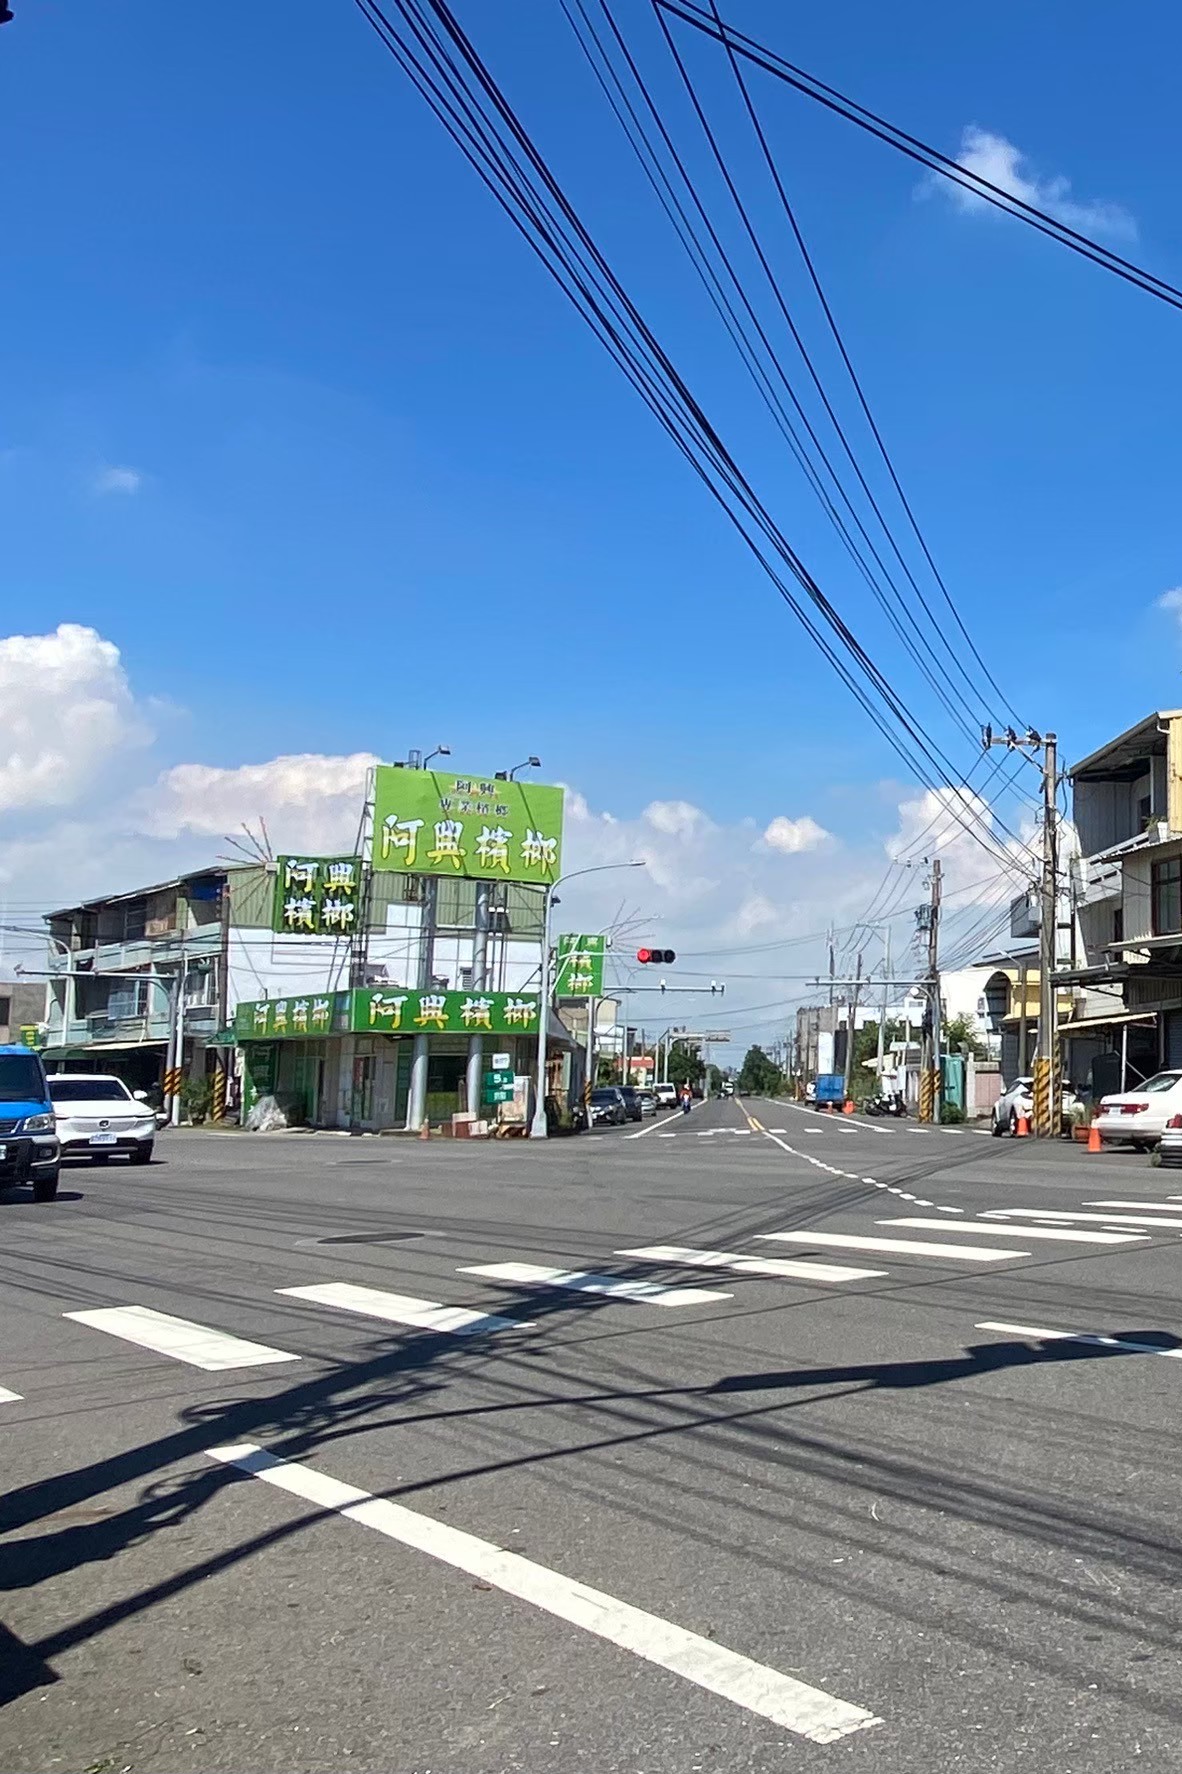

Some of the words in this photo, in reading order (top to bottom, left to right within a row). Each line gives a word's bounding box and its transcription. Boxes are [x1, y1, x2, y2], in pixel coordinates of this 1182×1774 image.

[381, 814, 558, 875] 阿興檳榔
[253, 998, 329, 1035] 阿興檳榔
[368, 992, 538, 1030] 阿興檳榔
